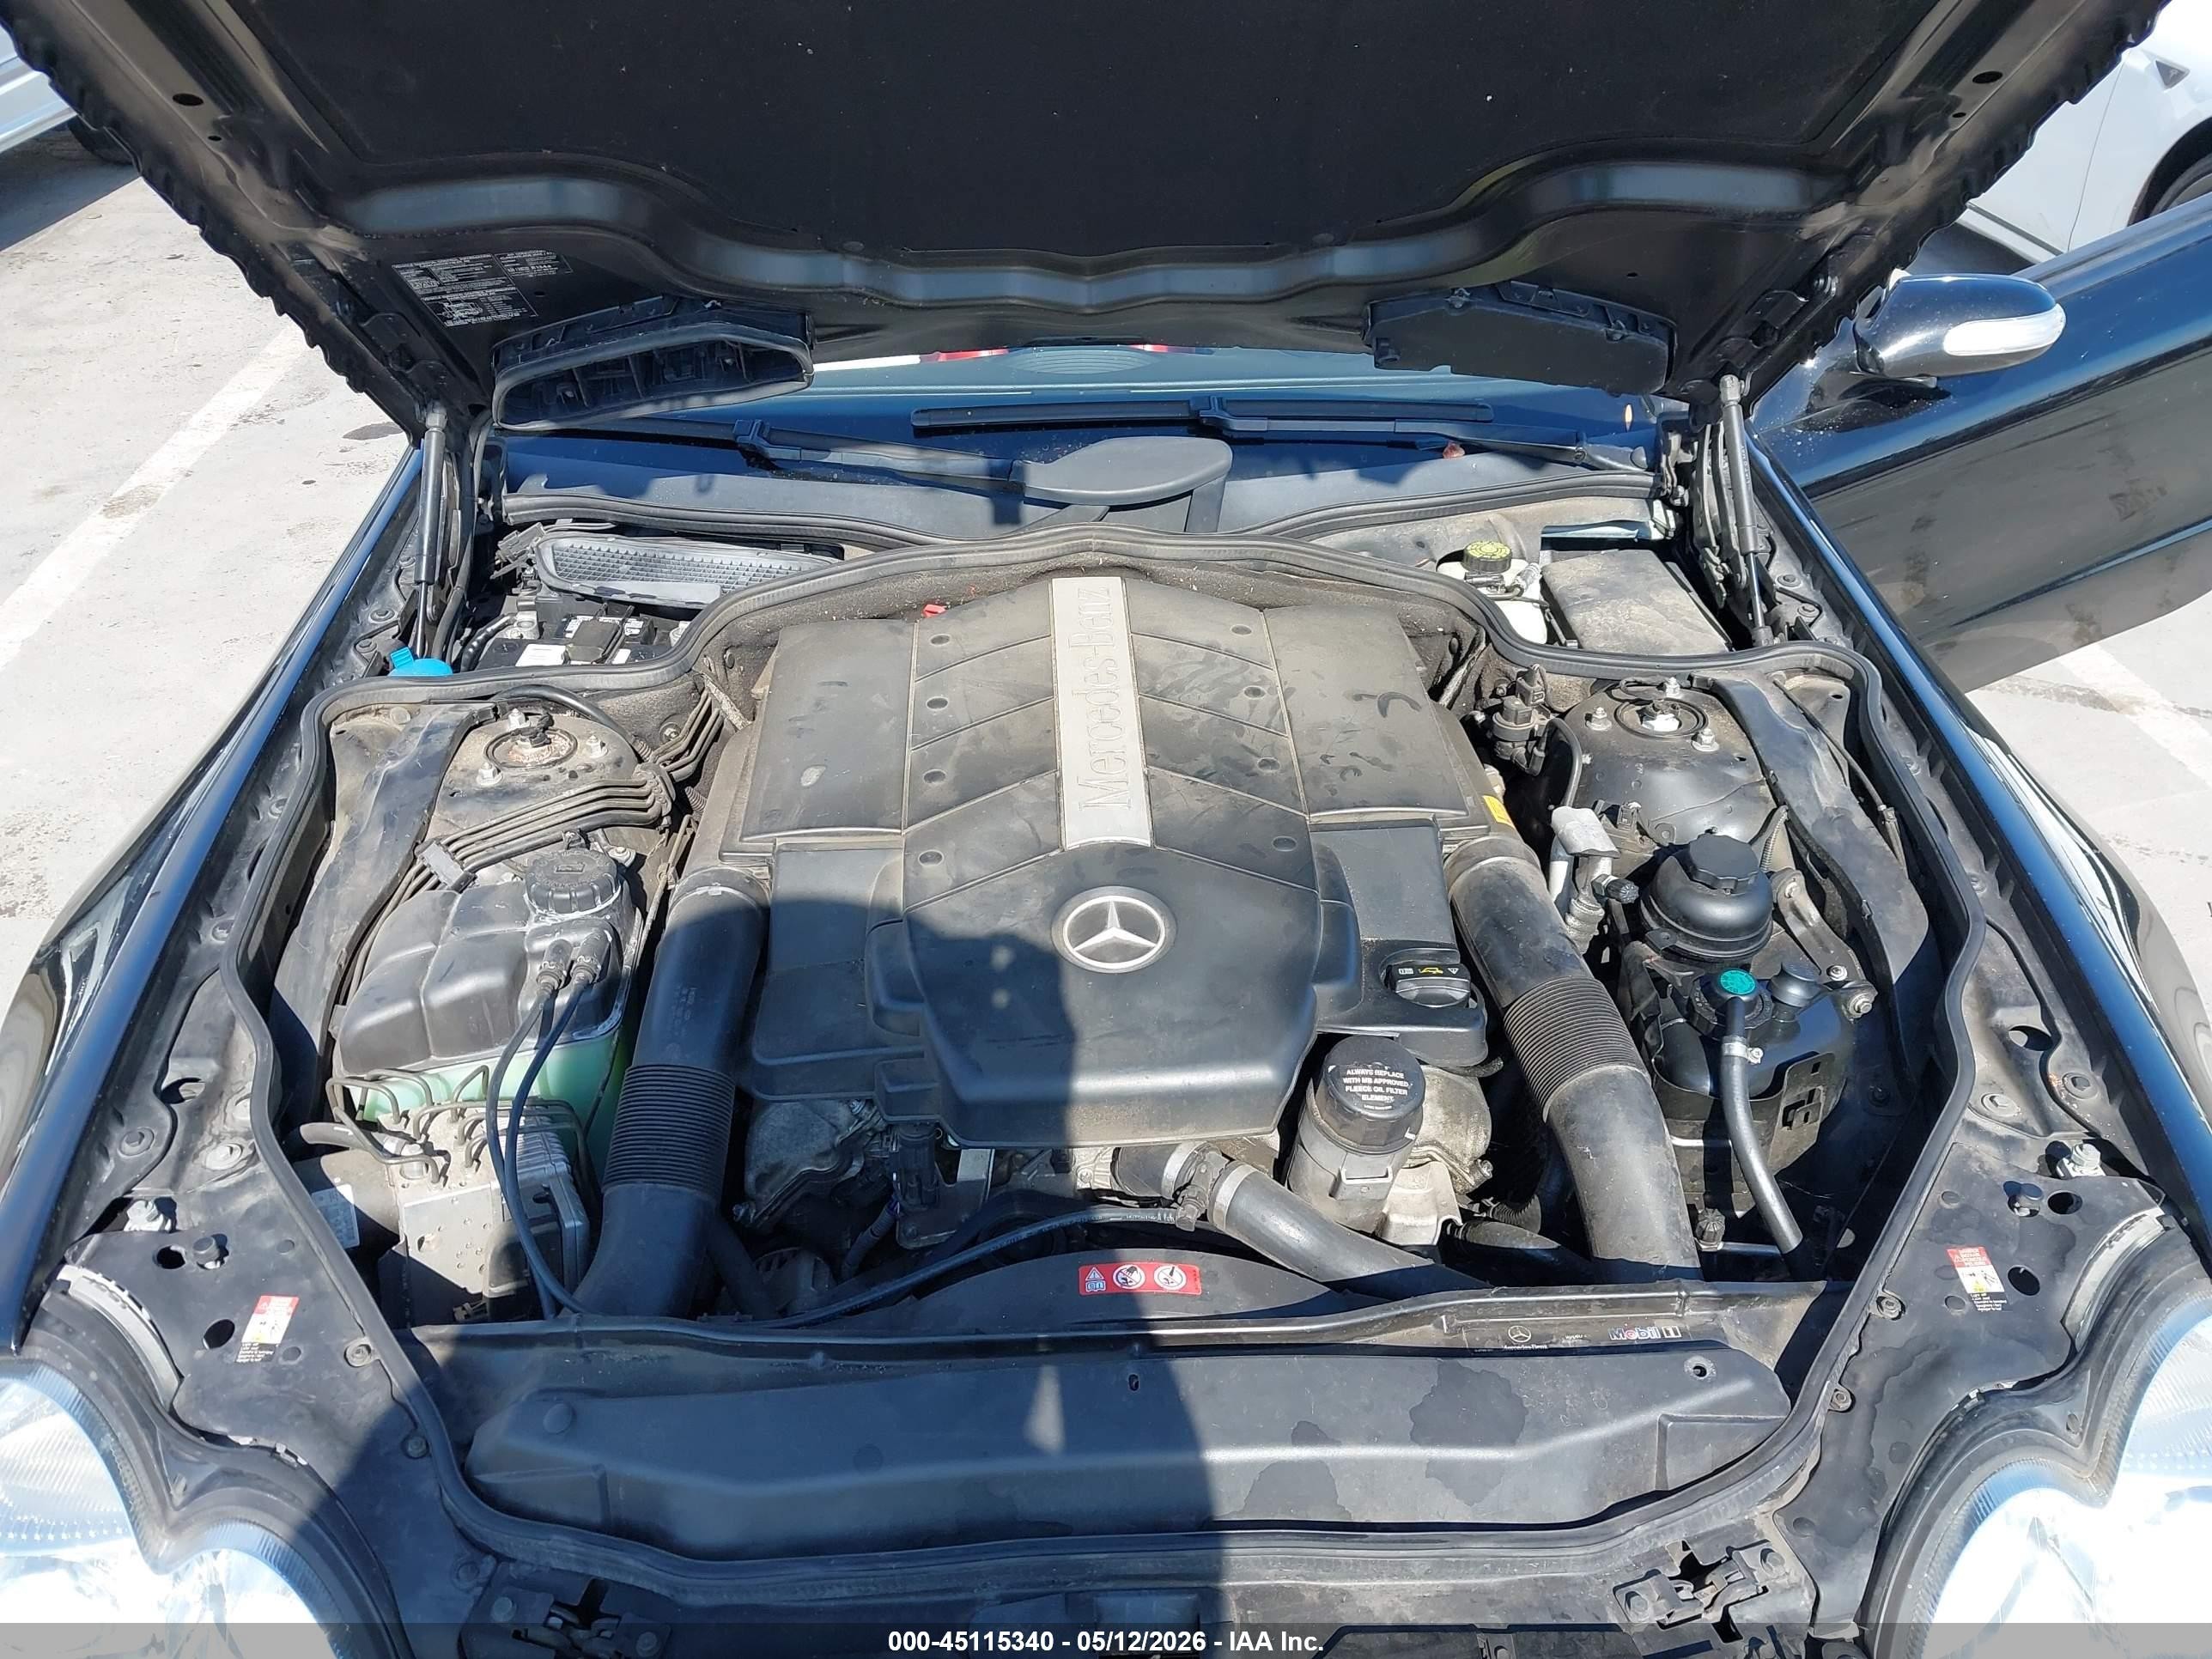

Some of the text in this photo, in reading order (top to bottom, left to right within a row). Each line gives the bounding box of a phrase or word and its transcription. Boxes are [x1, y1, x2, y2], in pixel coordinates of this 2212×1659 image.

[1069, 586, 1133, 811] Mercedes-Benz
[1375, 1070, 1405, 1079] REPLACE
[1374, 1079, 1409, 1087] APPROVED
[1608, 1326, 1662, 1340] Mobil
